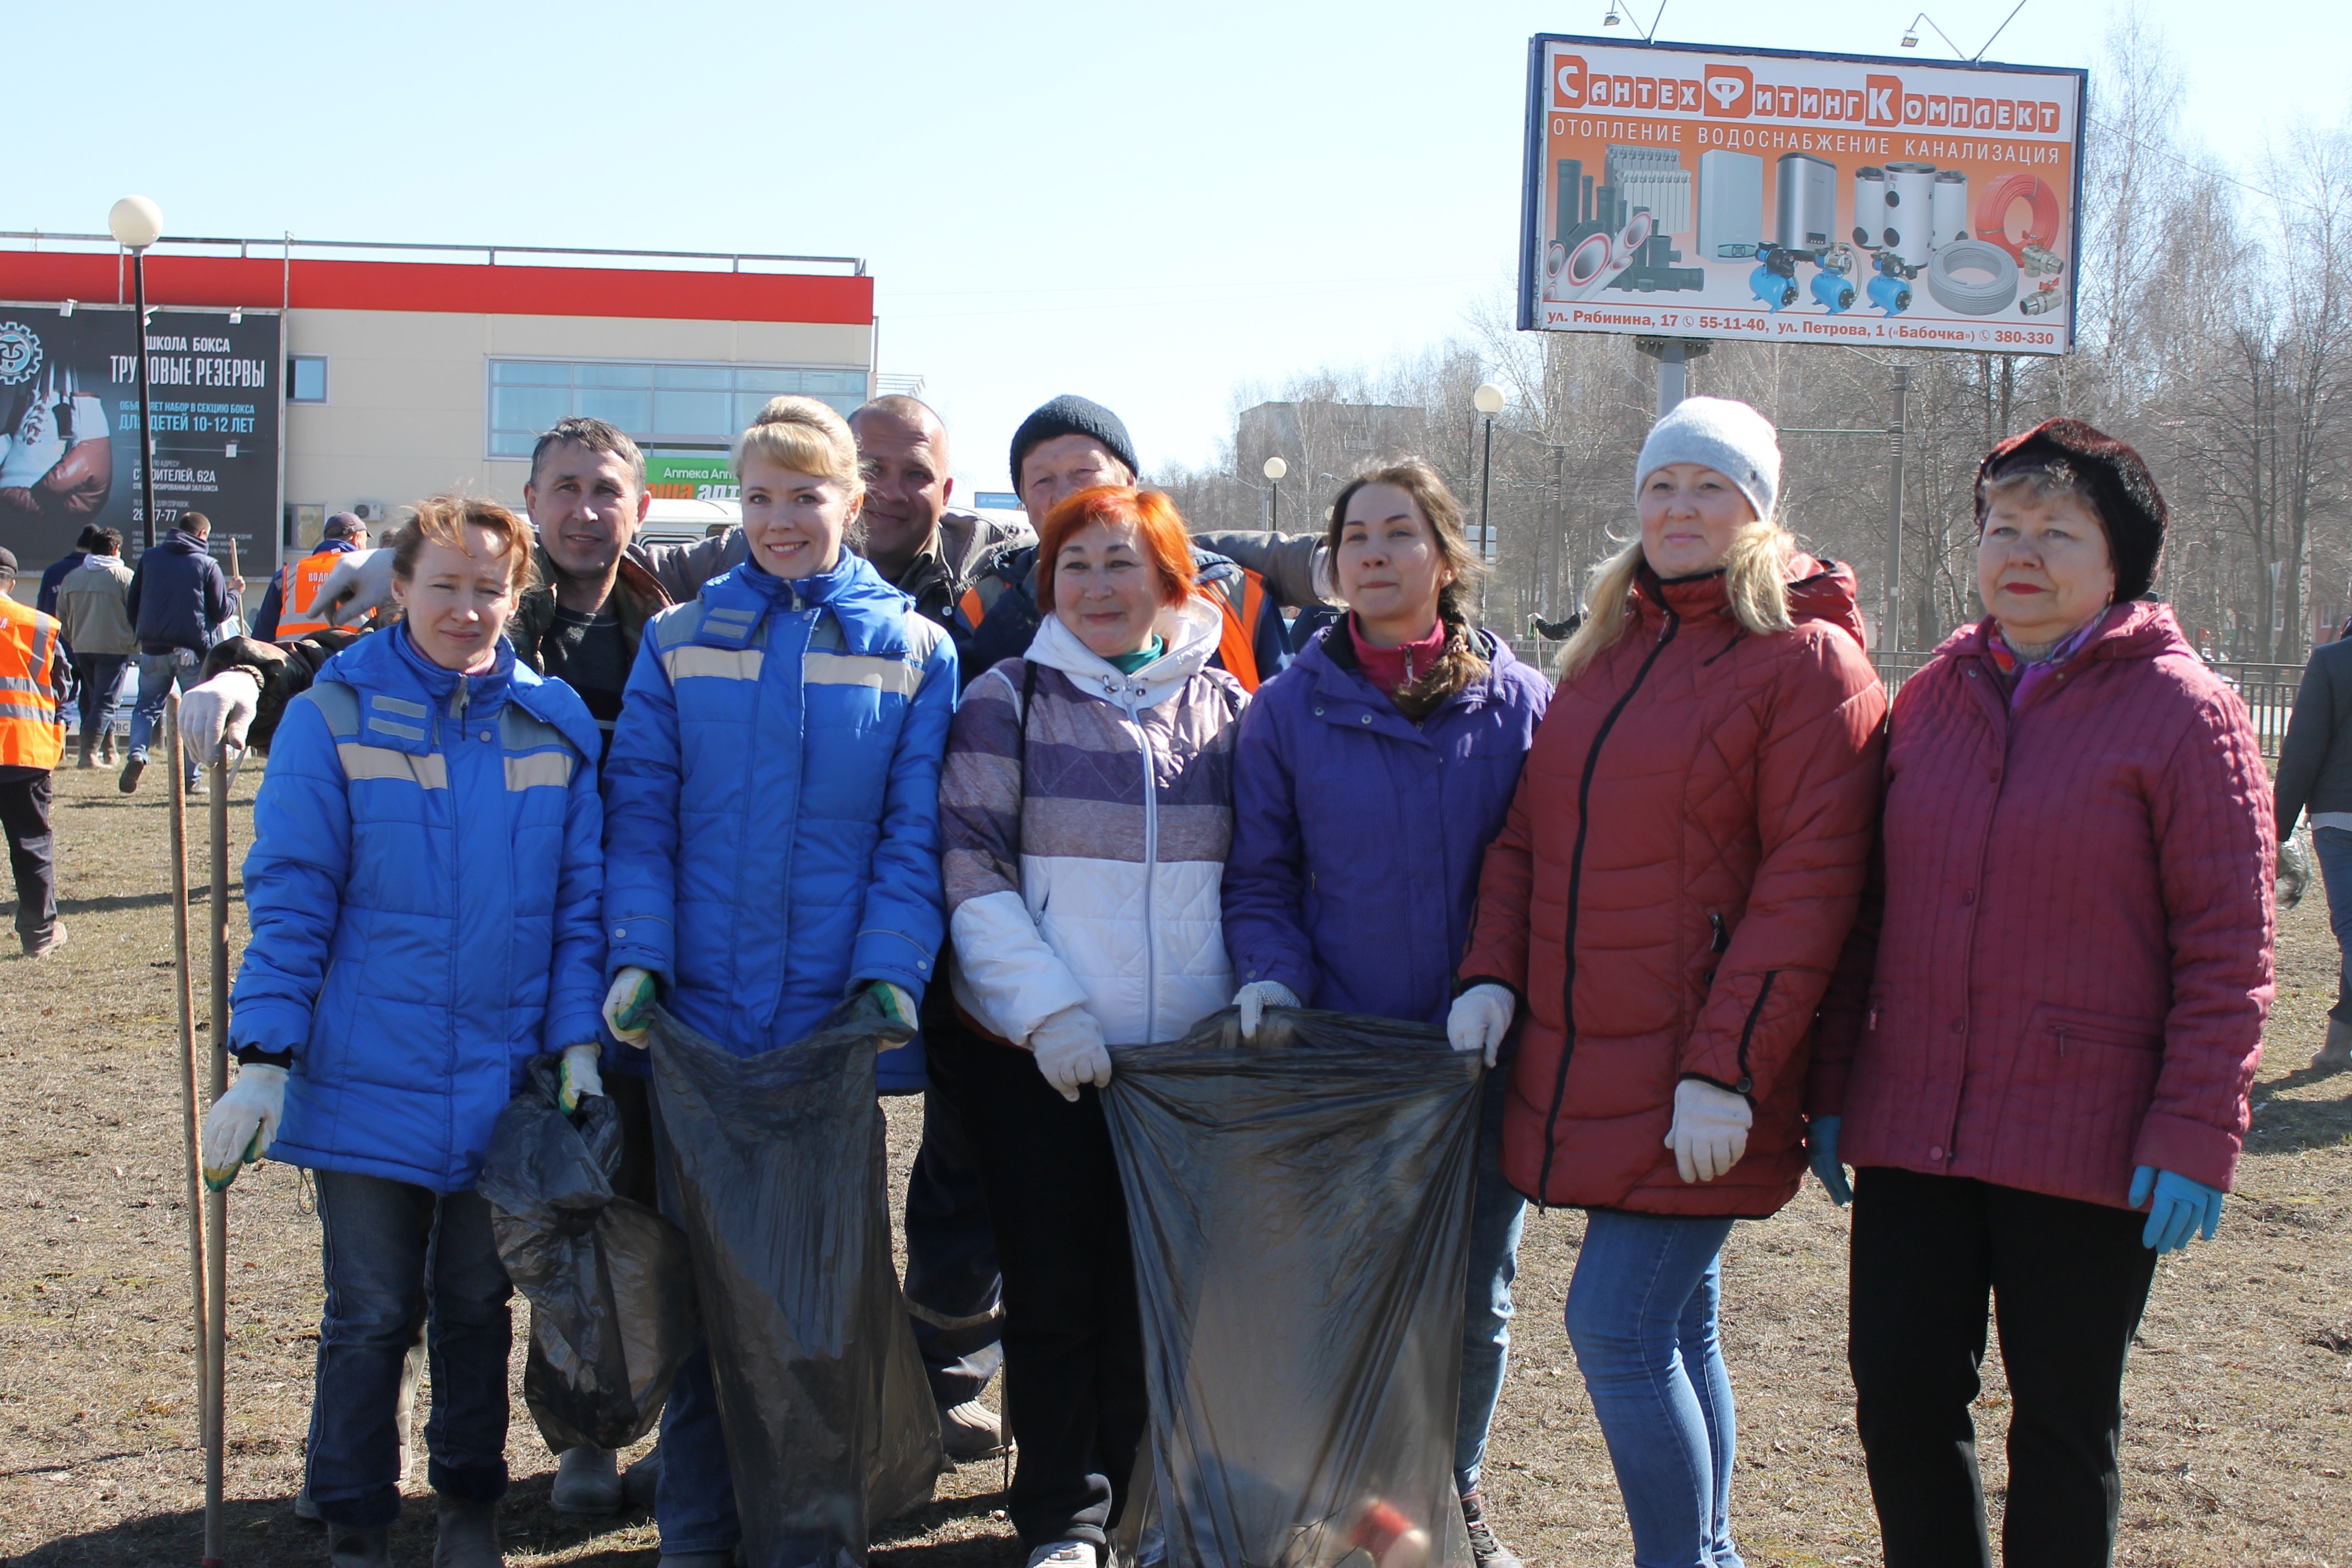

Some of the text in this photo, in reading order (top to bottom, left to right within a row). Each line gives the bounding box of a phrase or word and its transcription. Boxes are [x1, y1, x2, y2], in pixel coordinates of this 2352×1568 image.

[1553, 118, 2059, 166] ОТОПЛЕНИЕ ВОДОСНАБЖЕНИЕ КАНАЛИЗАЦИЯ
[1547, 311, 1568, 324] ул.
[1573, 310, 1656, 329] Рябинина,
[1660, 314, 1678, 326] 17
[1699, 316, 1770, 333] 55-11-40,
[1778, 322, 1798, 335] ул.
[1803, 321, 1871, 339] Петрова,
[1876, 324, 1885, 337] 1
[1994, 330, 2054, 345] 380-330
[145, 336, 230, 352] ШКОЛА БОКСА
[111, 356, 265, 388] ТРУОВЫЕ РЕЗЕРВЫ
[165, 401, 189, 412] НАБОР
[191, 402, 196, 413] В
[197, 403, 229, 415] СЕКЦИЮ
[231, 404, 255, 415] БОКСА
[118, 415, 140, 431] ДЛ
[151, 413, 189, 431] ДЕТЕЙ
[231, 418, 255, 433] ЛЕТ
[197, 470, 216, 483] 62А
[663, 467, 709, 479] Аптека
[645, 482, 741, 500] аша апт
